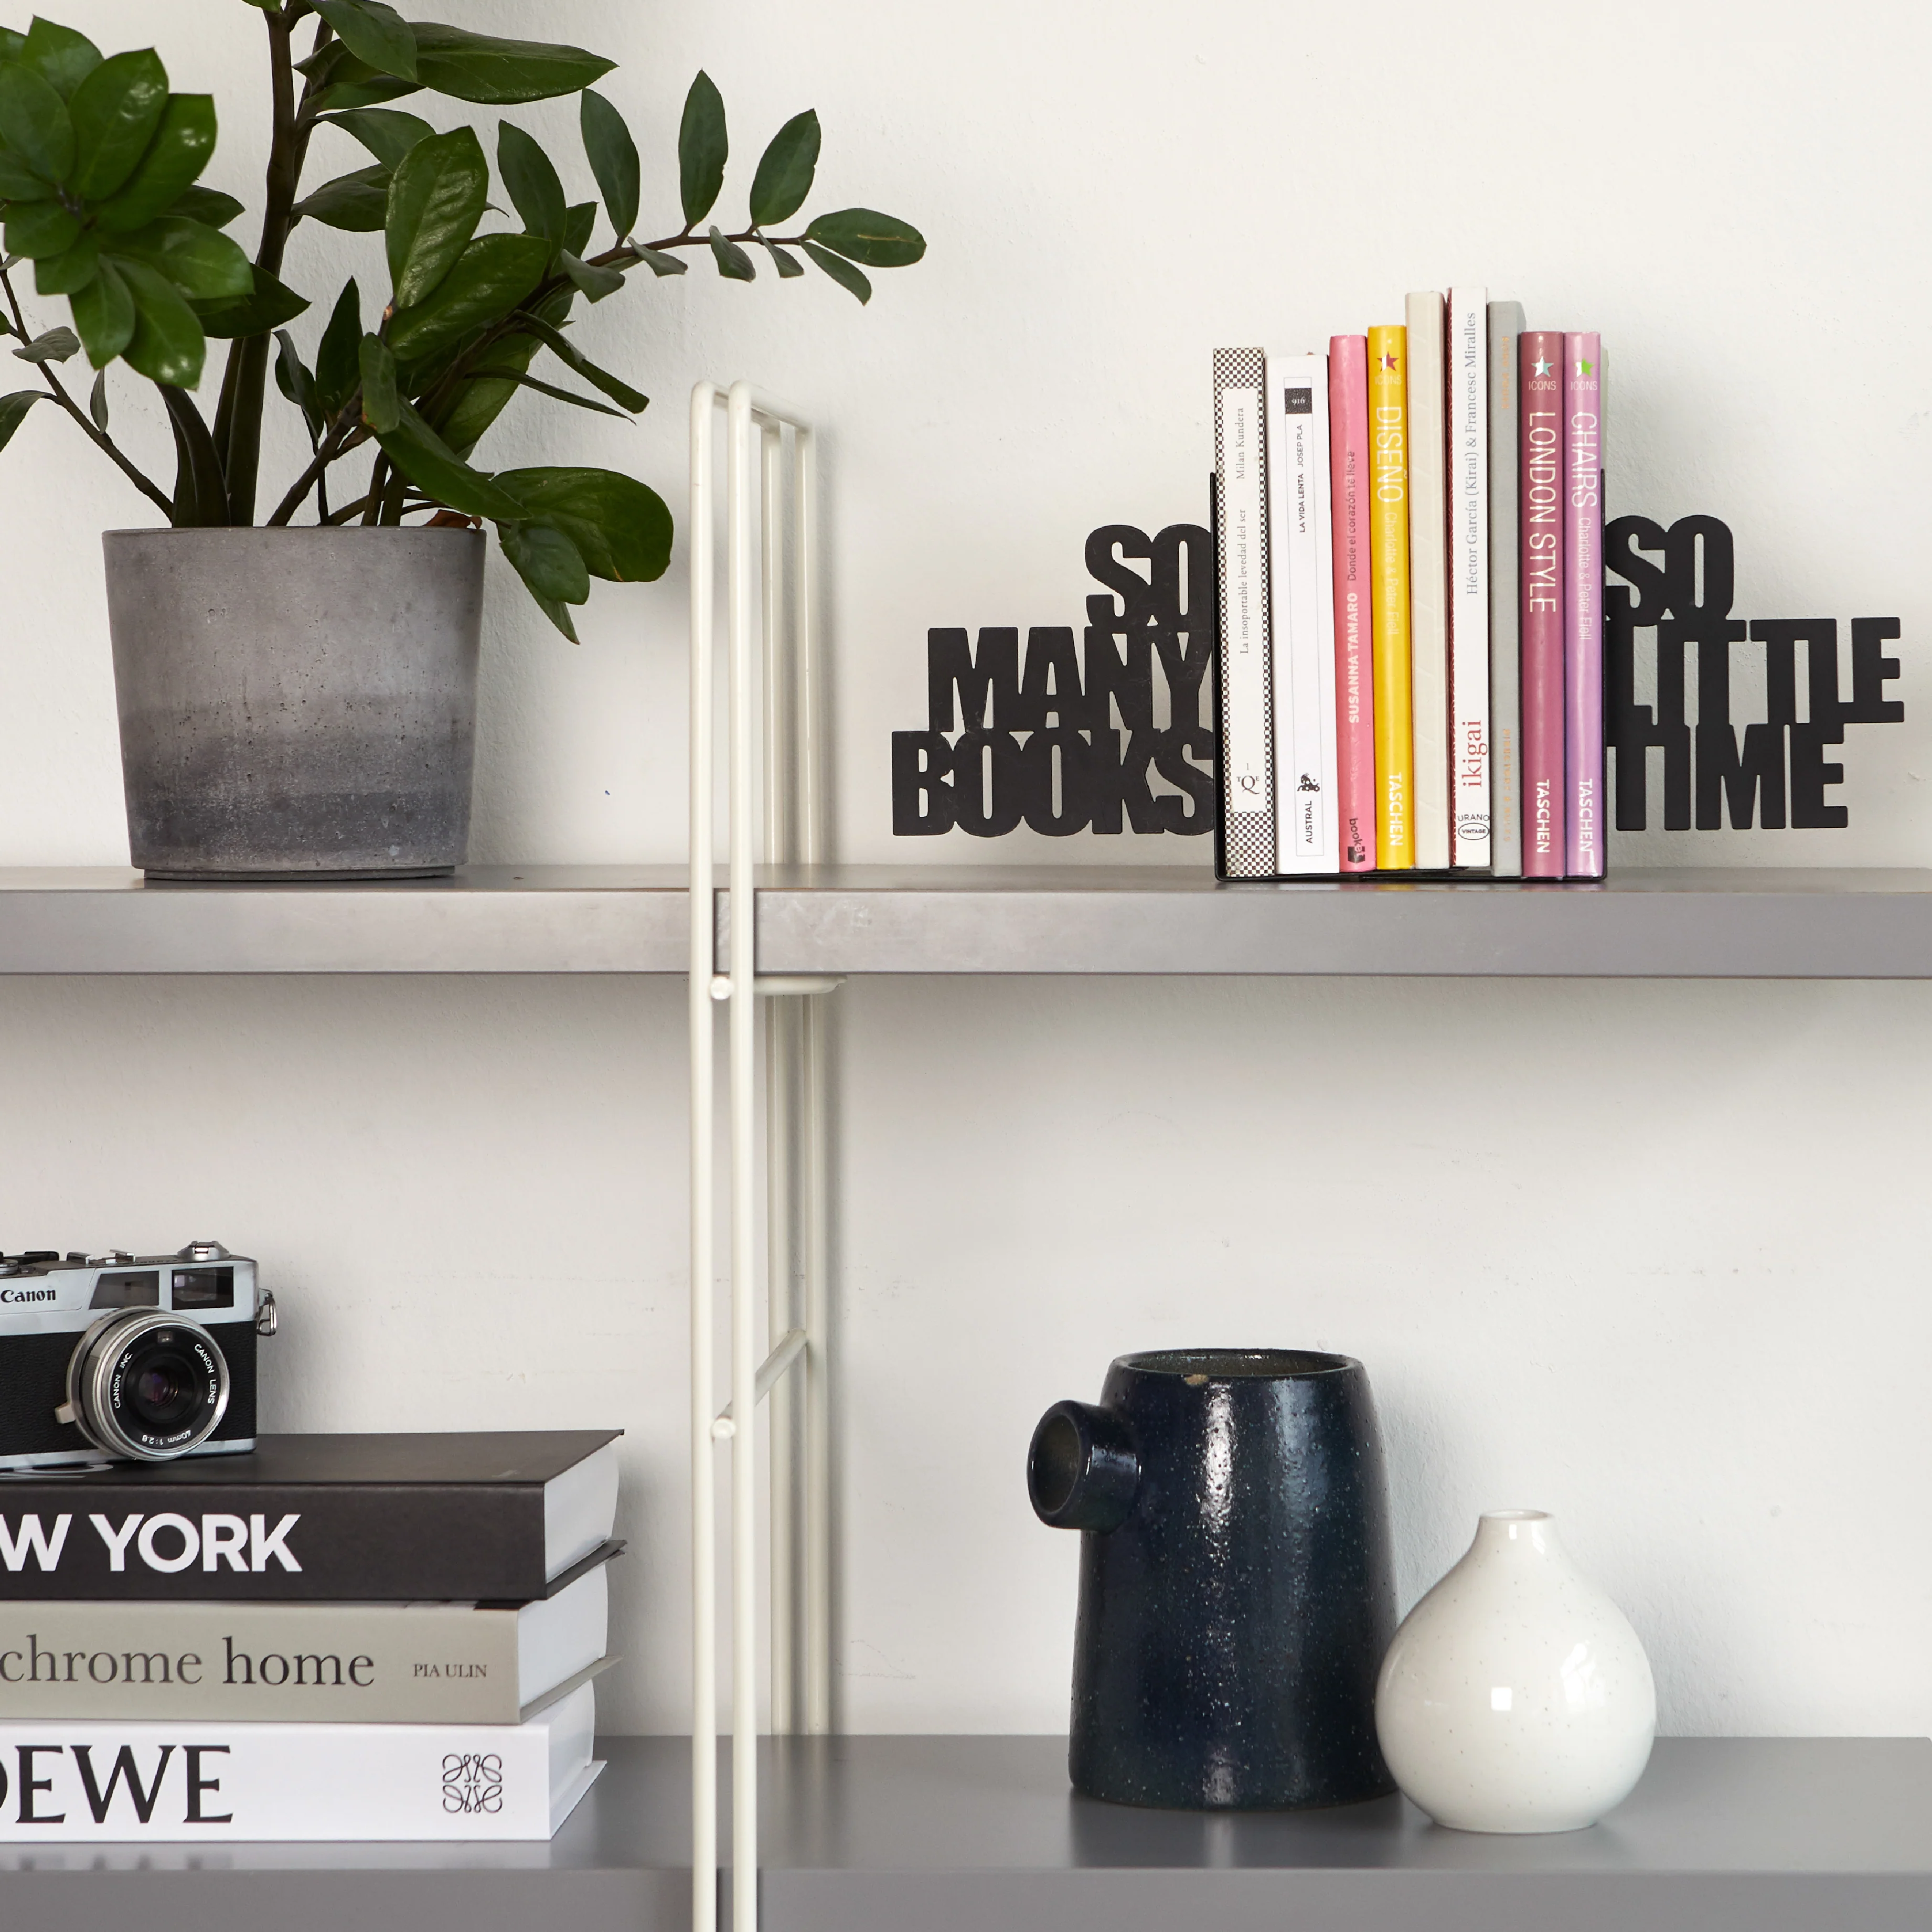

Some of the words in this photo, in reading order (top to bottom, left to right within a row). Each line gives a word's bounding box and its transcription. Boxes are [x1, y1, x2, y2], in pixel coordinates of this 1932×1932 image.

[1464, 313, 1476, 368] Miralles
[1374, 375, 1402, 386] ICONS
[1465, 372, 1476, 433] Francesc
[1529, 381, 1556, 391] ICONS
[1571, 381, 1598, 391] ICONS
[1235, 408, 1244, 447] Kundera
[1465, 438, 1476, 447] &
[1236, 452, 1245, 479] Milan
[1346, 452, 1355, 475] lleve
[1376, 407, 1407, 503] DISEÑO
[1465, 452, 1479, 496] (Kirai)
[1529, 412, 1556, 522] LONDON
[1571, 411, 1597, 508] CHAIRS
[1346, 478, 1355, 488] te
[1237, 526, 1246, 540] del
[1298, 522, 1305, 532] LA
[1346, 491, 1355, 533] corazón
[1465, 500, 1477, 544] García
[1237, 543, 1247, 578] levedad
[1347, 536, 1355, 545] el
[1385, 513, 1397, 563] Charlotte
[1578, 517, 1592, 568] Charlotte
[1085, 524, 1213, 627] SO
[1347, 547, 1356, 581] Donde
[1385, 567, 1396, 575] &
[1466, 548, 1477, 594] Héctor
[1529, 533, 1556, 613] STYLE
[1605, 515, 1734, 626] SO
[1238, 582, 1250, 639] insoportable
[1386, 578, 1399, 608] Peter
[1579, 584, 1592, 613] Peter
[1347, 592, 1359, 652] TAMARO
[1386, 612, 1399, 635] Fiell
[1579, 617, 1592, 640] Fiell
[1240, 643, 1248, 654] La
[928, 626, 1213, 732] MANY
[1348, 655, 1359, 723] SUSANNA
[1605, 617, 1904, 727] LITTLE
[1461, 720, 1488, 787] ikigai
[892, 730, 1214, 836] BOOKS
[1606, 724, 1848, 831] TIME
[1389, 772, 1403, 846] TASCHEN
[1536, 779, 1551, 852] TASCHEN
[1579, 778, 1593, 851] TASCHEN
[1, 1289, 56, 1303] Canon
[120, 1352, 133, 1369] INC
[195, 1344, 215, 1373] CANON
[207, 1379, 217, 1404] LENS
[167, 1429, 191, 1443] 40mm
[88, 1513, 303, 1573] YORK
[0, 1634, 203, 1684] chrome
[222, 1636, 375, 1687] home
[413, 1664, 441, 1678] PIA
[445, 1664, 487, 1678] ULIN
[0, 1745, 234, 1823] EWE
